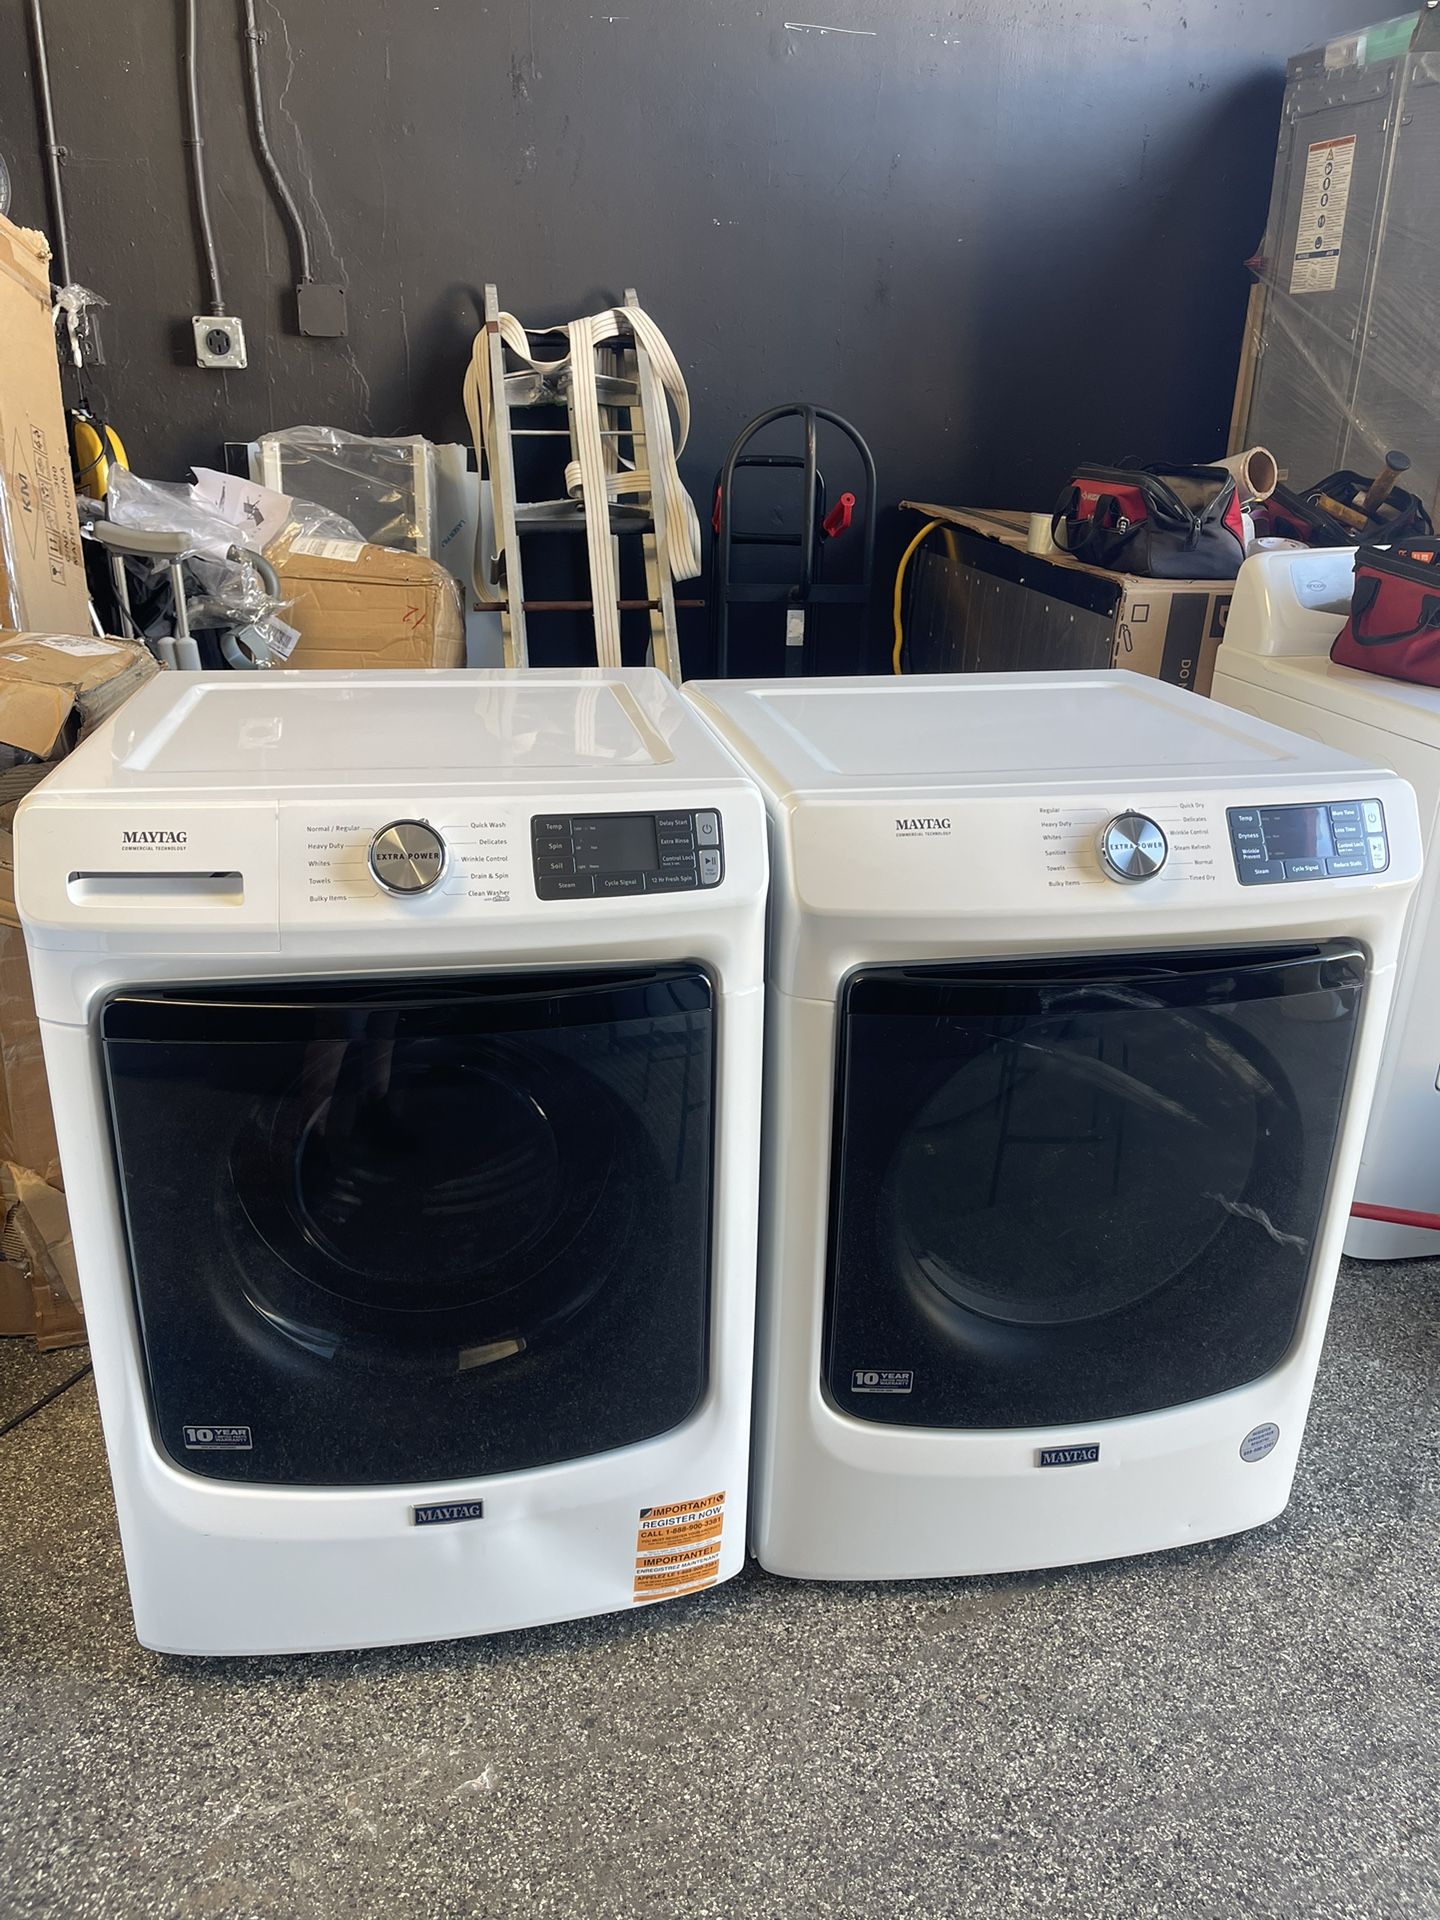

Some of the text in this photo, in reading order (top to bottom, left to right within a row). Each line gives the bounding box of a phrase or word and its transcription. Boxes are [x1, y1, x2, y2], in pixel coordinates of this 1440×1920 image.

[60, 467, 71, 508] CHINA
[1179, 802, 1194, 810] Quick
[470, 822, 488, 830] Quick
[546, 823, 563, 831] Temp
[658, 819, 674, 827] Delay
[896, 818, 951, 831] MAYTAG
[336, 824, 360, 833] Regular
[122, 831, 188, 843] MAYTAG
[674, 837, 690, 845] Rinse
[307, 842, 345, 851] Heavy Duty
[548, 842, 563, 850] Spin
[1110, 841, 1163, 851] EXTRA POWER
[376, 852, 440, 861] EXTRA POWER
[494, 872, 509, 880] Spin
[665, 875, 679, 883] Fresh
[679, 874, 693, 882] Spin
[1206, 874, 1216, 882] Dry
[309, 877, 331, 885] Towels
[558, 881, 576, 889] Steam
[604, 878, 637, 888] Cycle Signal
[486, 889, 510, 897] Washer
[309, 895, 329, 903] Bulky
[856, 1372, 879, 1385] 10
[186, 1428, 213, 1442] 10
[1042, 1448, 1097, 1464] MAYTAG
[417, 1504, 481, 1522] MAYTAG
[642, 1505, 722, 1529] REGISTER NOW
[640, 1529, 663, 1539] CALL
[643, 1546, 714, 1566] IMPORTANTE!
[636, 1563, 680, 1575] ENREGISTREZ
[681, 1553, 720, 1568] MAINTENANT
[637, 1571, 667, 1581] APPELEZ
